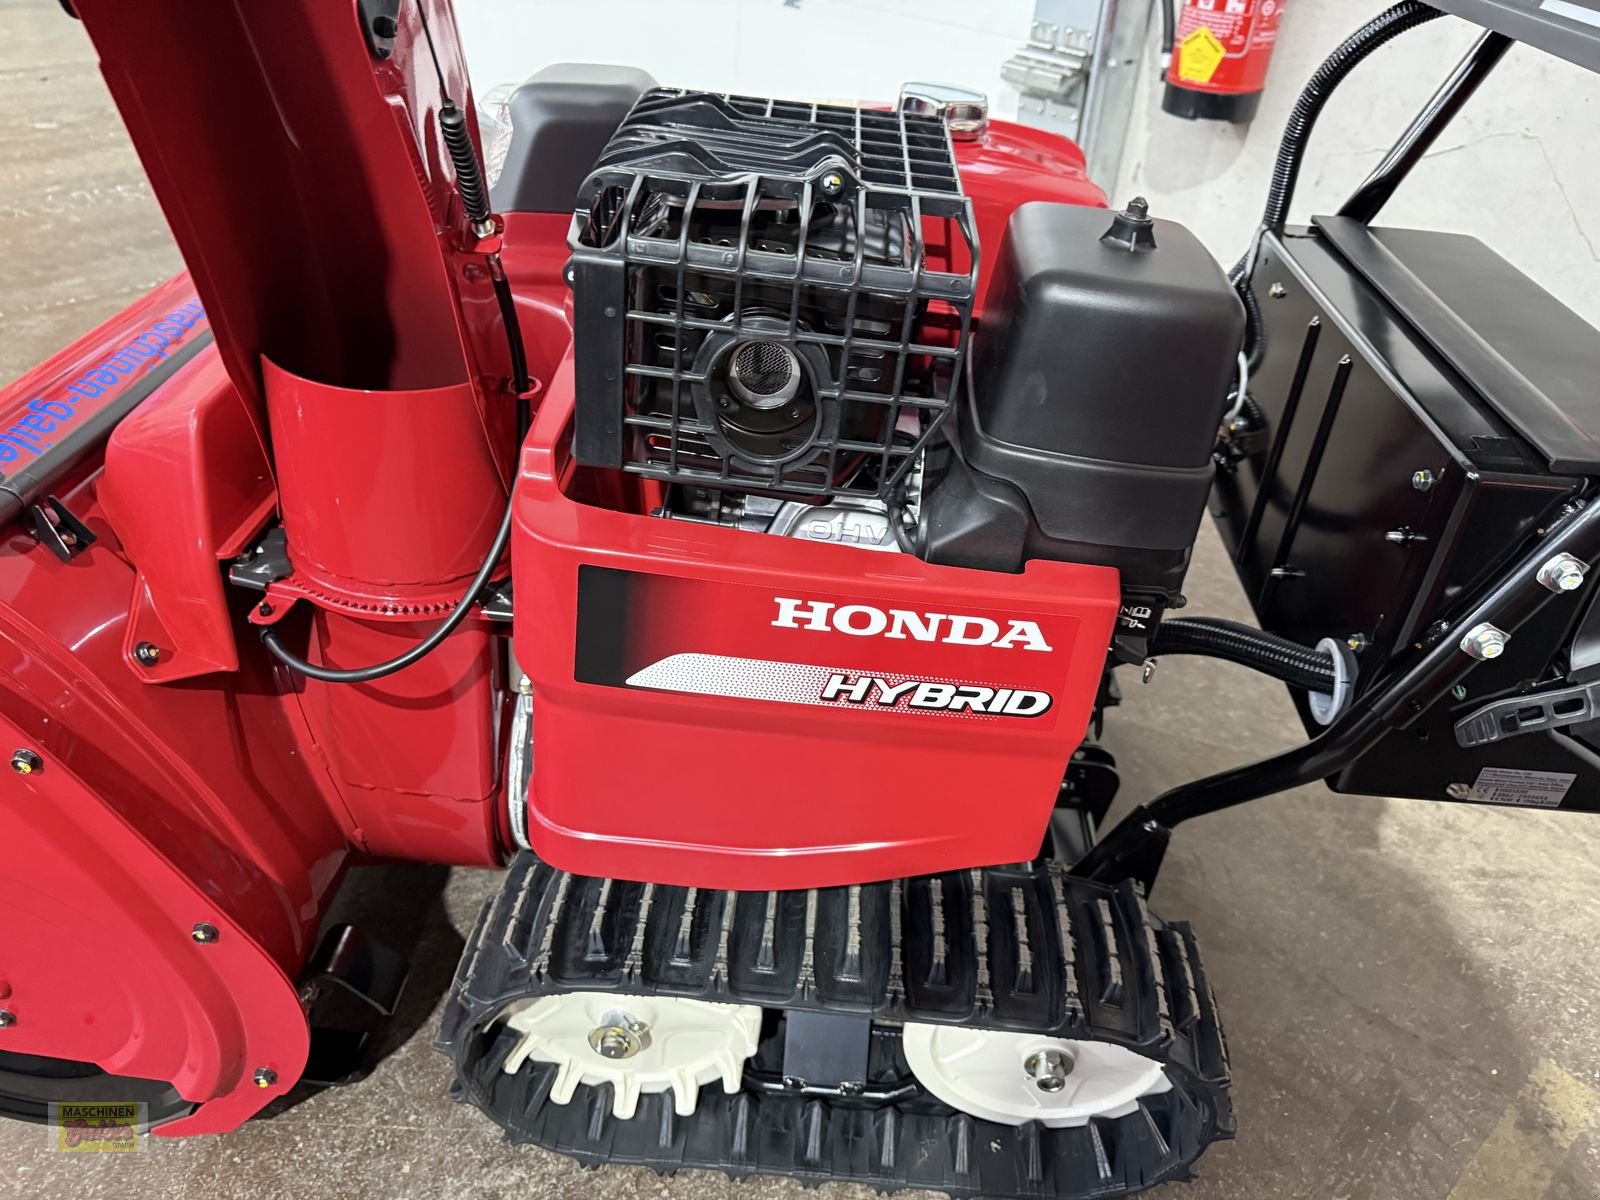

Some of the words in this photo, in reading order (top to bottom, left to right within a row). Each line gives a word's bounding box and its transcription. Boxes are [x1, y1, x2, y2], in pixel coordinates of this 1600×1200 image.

[0, 298, 206, 469] maschinen-gaile
[808, 519, 889, 546] OHV
[771, 597, 1052, 652] HONDA
[823, 674, 1053, 717] HYBRID
